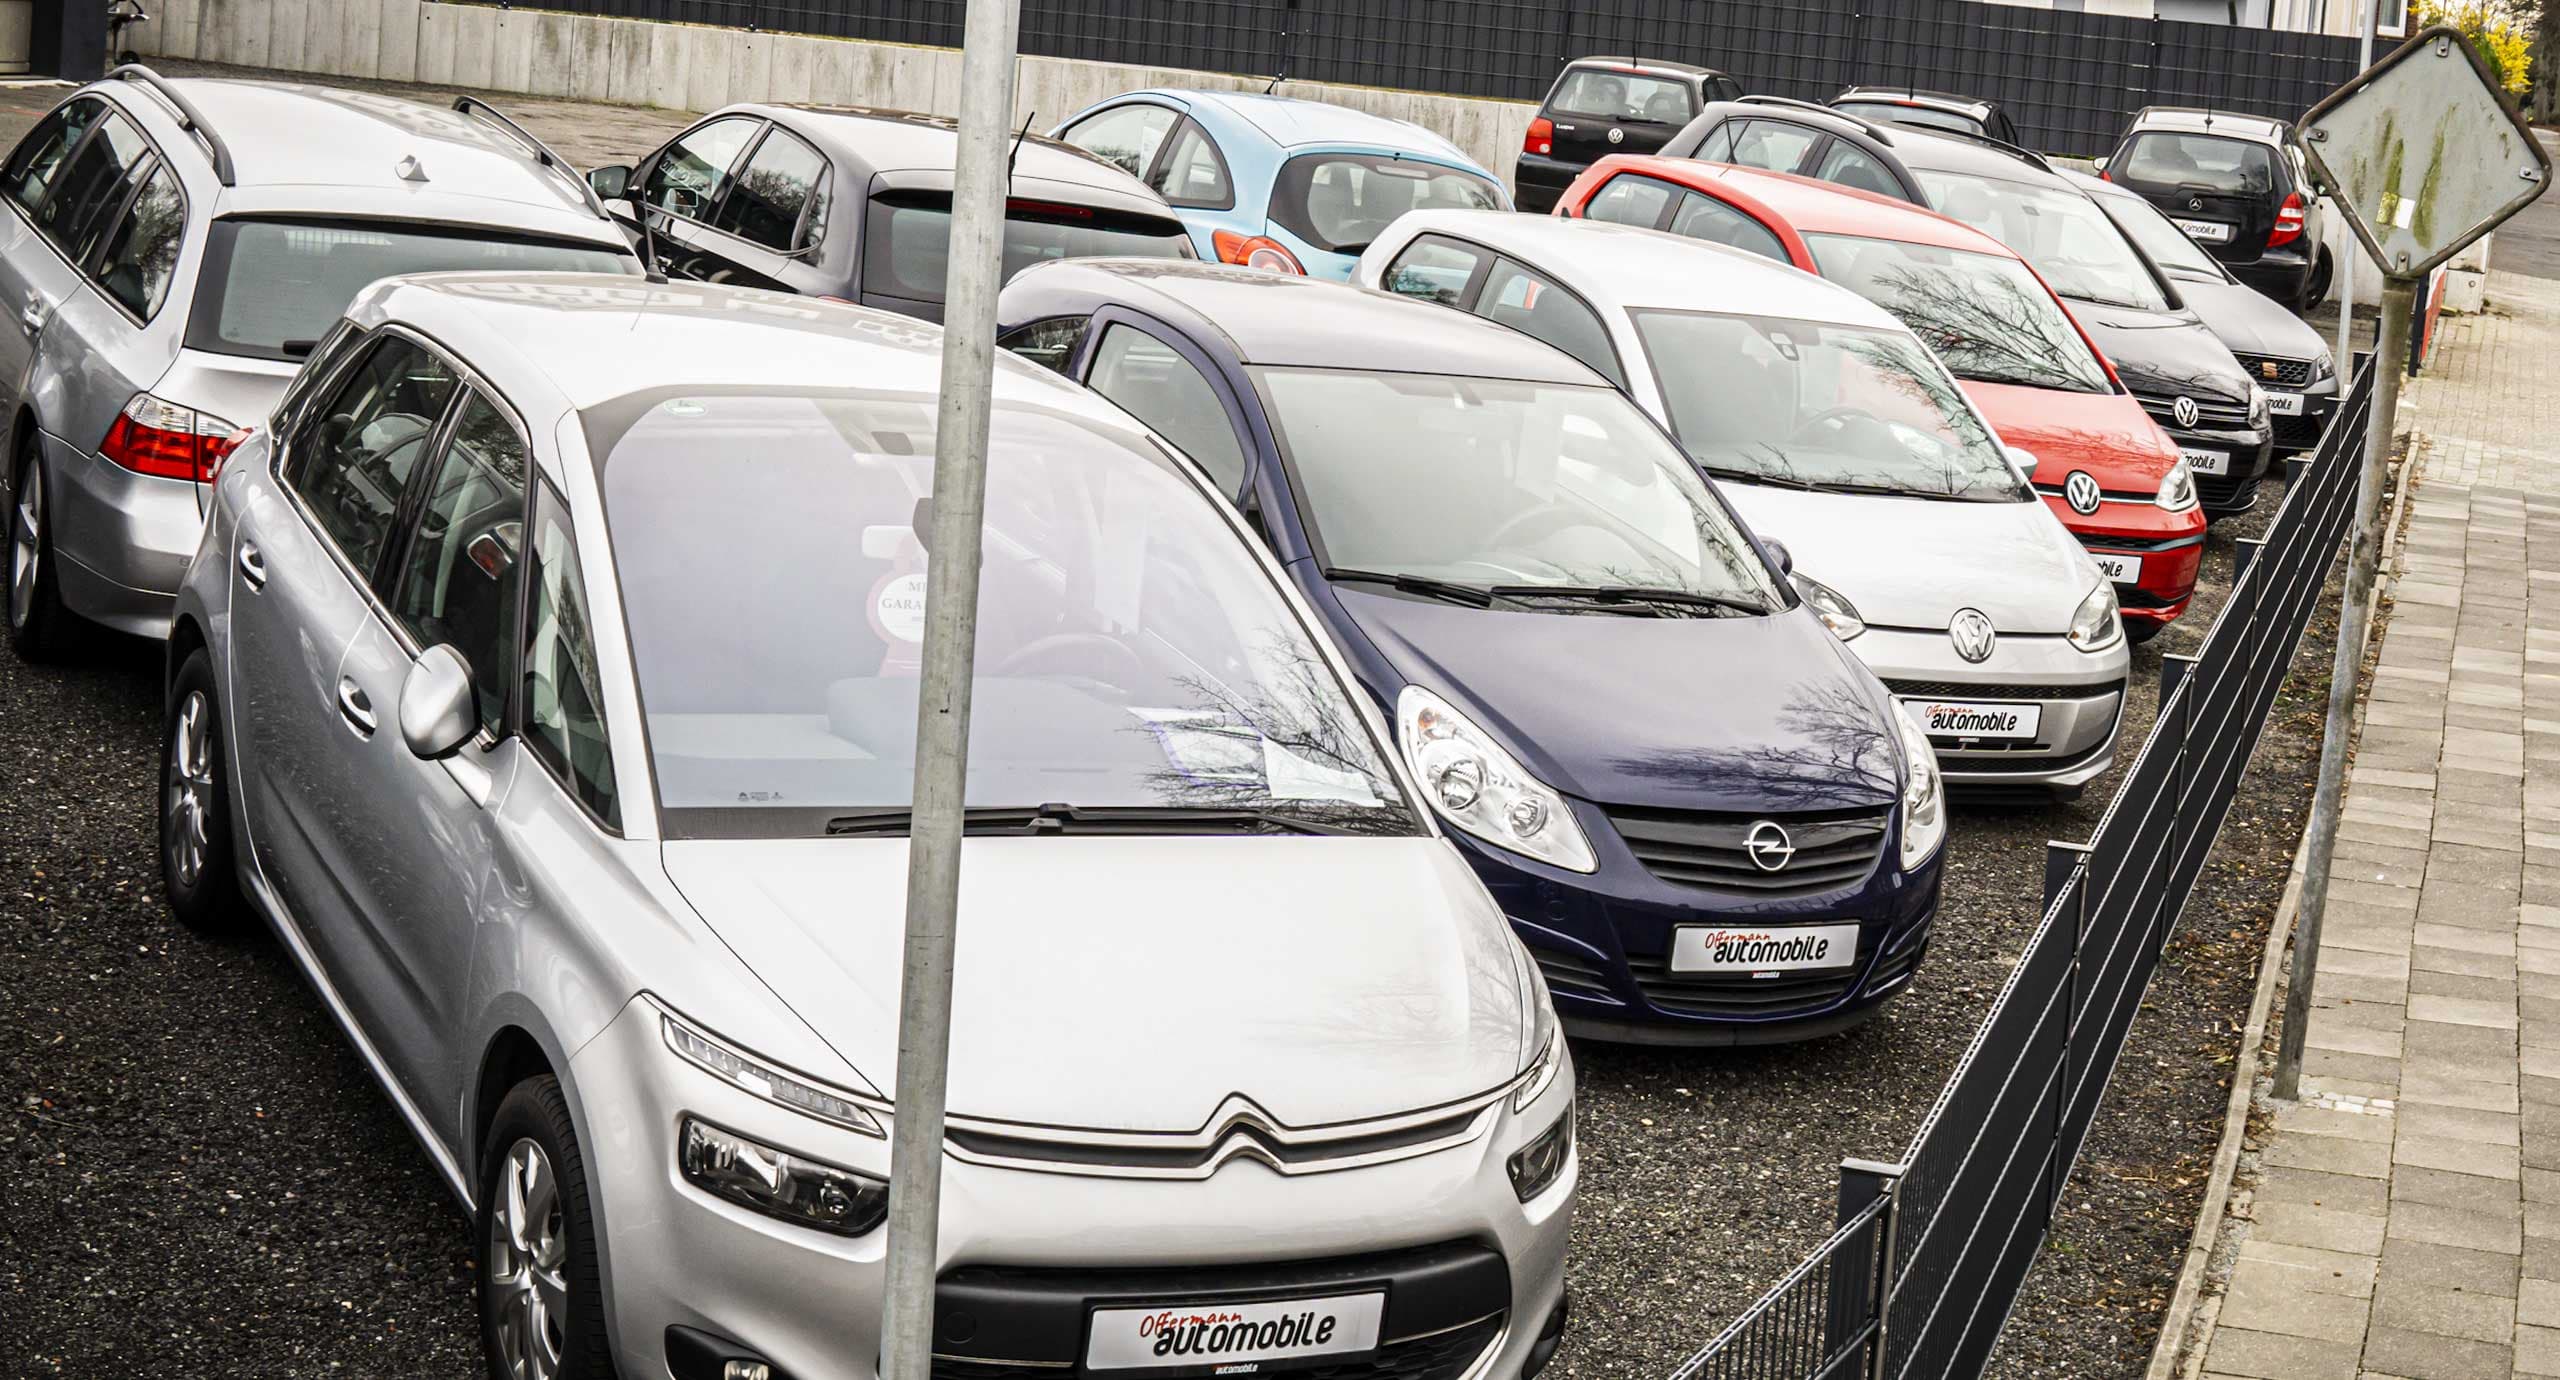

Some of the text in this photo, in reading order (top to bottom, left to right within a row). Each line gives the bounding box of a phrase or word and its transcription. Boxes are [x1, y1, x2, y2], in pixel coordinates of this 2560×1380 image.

[906, 581, 927, 593] MI
[881, 598, 922, 611] GARA
[1931, 711, 2017, 732] automobile
[1705, 930, 1770, 949] Offermann
[1713, 936, 1829, 963] automobile
[1139, 1311, 1243, 1338] Offermann
[1153, 1311, 1337, 1356] automobile
